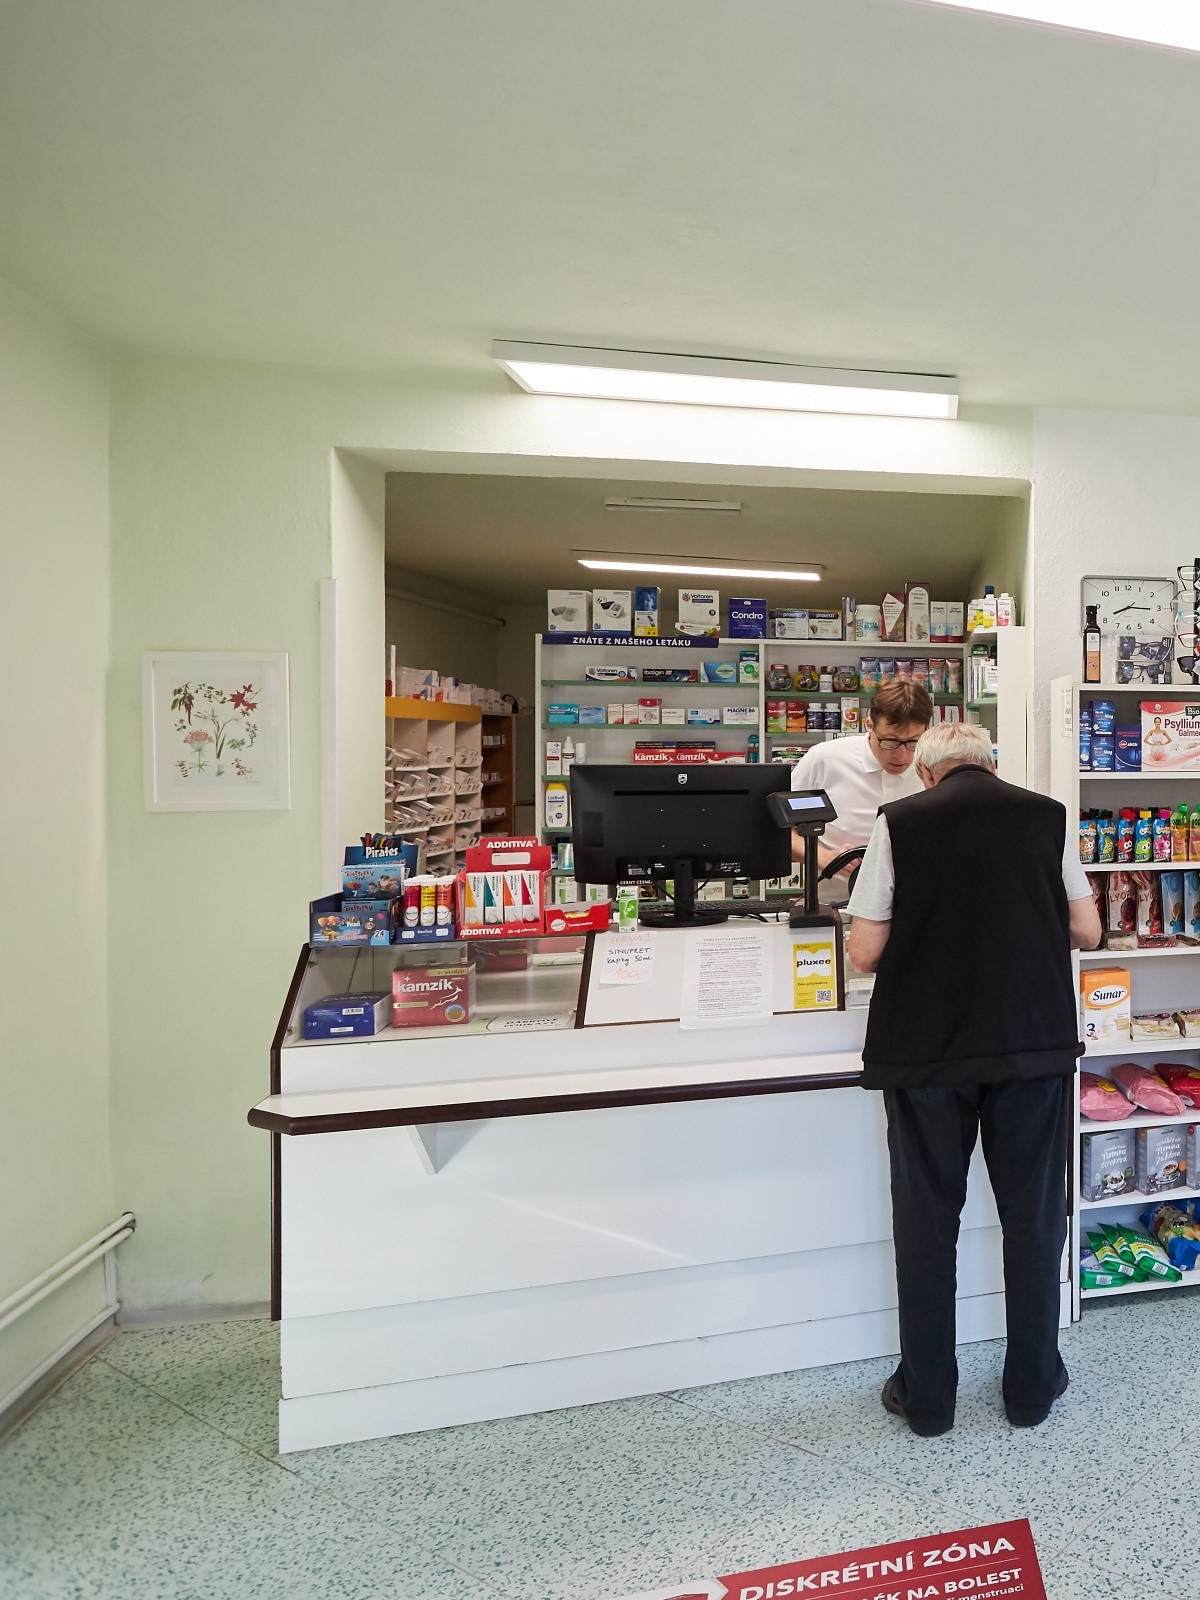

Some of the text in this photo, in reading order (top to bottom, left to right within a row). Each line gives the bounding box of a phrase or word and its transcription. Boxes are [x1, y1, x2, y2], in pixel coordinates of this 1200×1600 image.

[731, 611, 763, 619] Condro
[1137, 622, 1142, 630] 5
[572, 636, 603, 645] ZNÁTE
[614, 636, 653, 646] NAŠEHO
[655, 637, 691, 647] LETÁKU
[634, 753, 668, 762] kamzík
[486, 840, 534, 849] ADDITIVA
[365, 846, 399, 859] Pirates
[460, 928, 502, 937] ADDITIVA
[609, 934, 643, 945] SLEVA
[608, 947, 652, 955] SINUPRET
[796, 957, 832, 968] pluxee
[397, 979, 454, 993] kamzík
[1092, 988, 1125, 1001] Sunar
[1086, 1022, 1096, 1038] 3
[739, 1537, 1015, 1600] DISKRÉTNÍ ZÓNA
[907, 1584, 940, 1600] NA
[944, 1568, 1022, 1594] BOLEST
